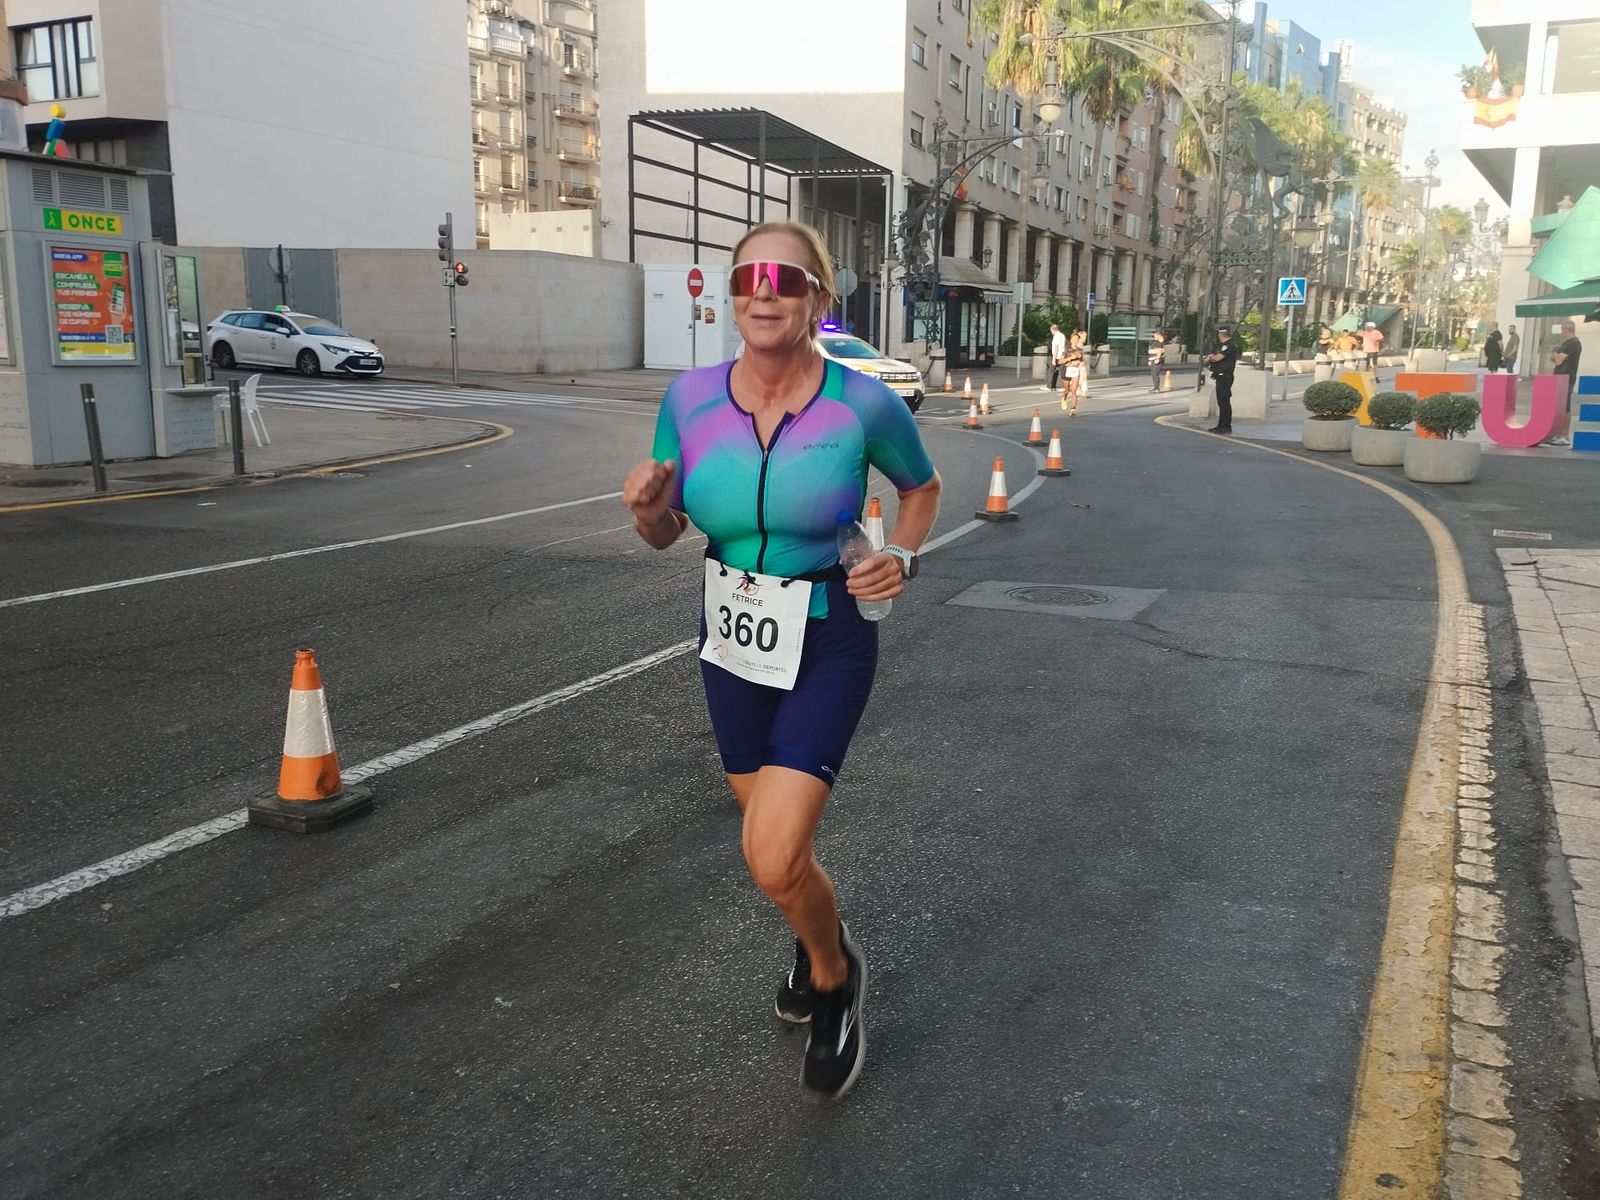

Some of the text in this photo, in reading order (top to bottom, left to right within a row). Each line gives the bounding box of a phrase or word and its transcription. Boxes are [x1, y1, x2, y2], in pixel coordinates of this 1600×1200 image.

[68, 213, 117, 232] ONCE
[731, 592, 764, 607] FETRICE
[718, 604, 779, 653] 360
